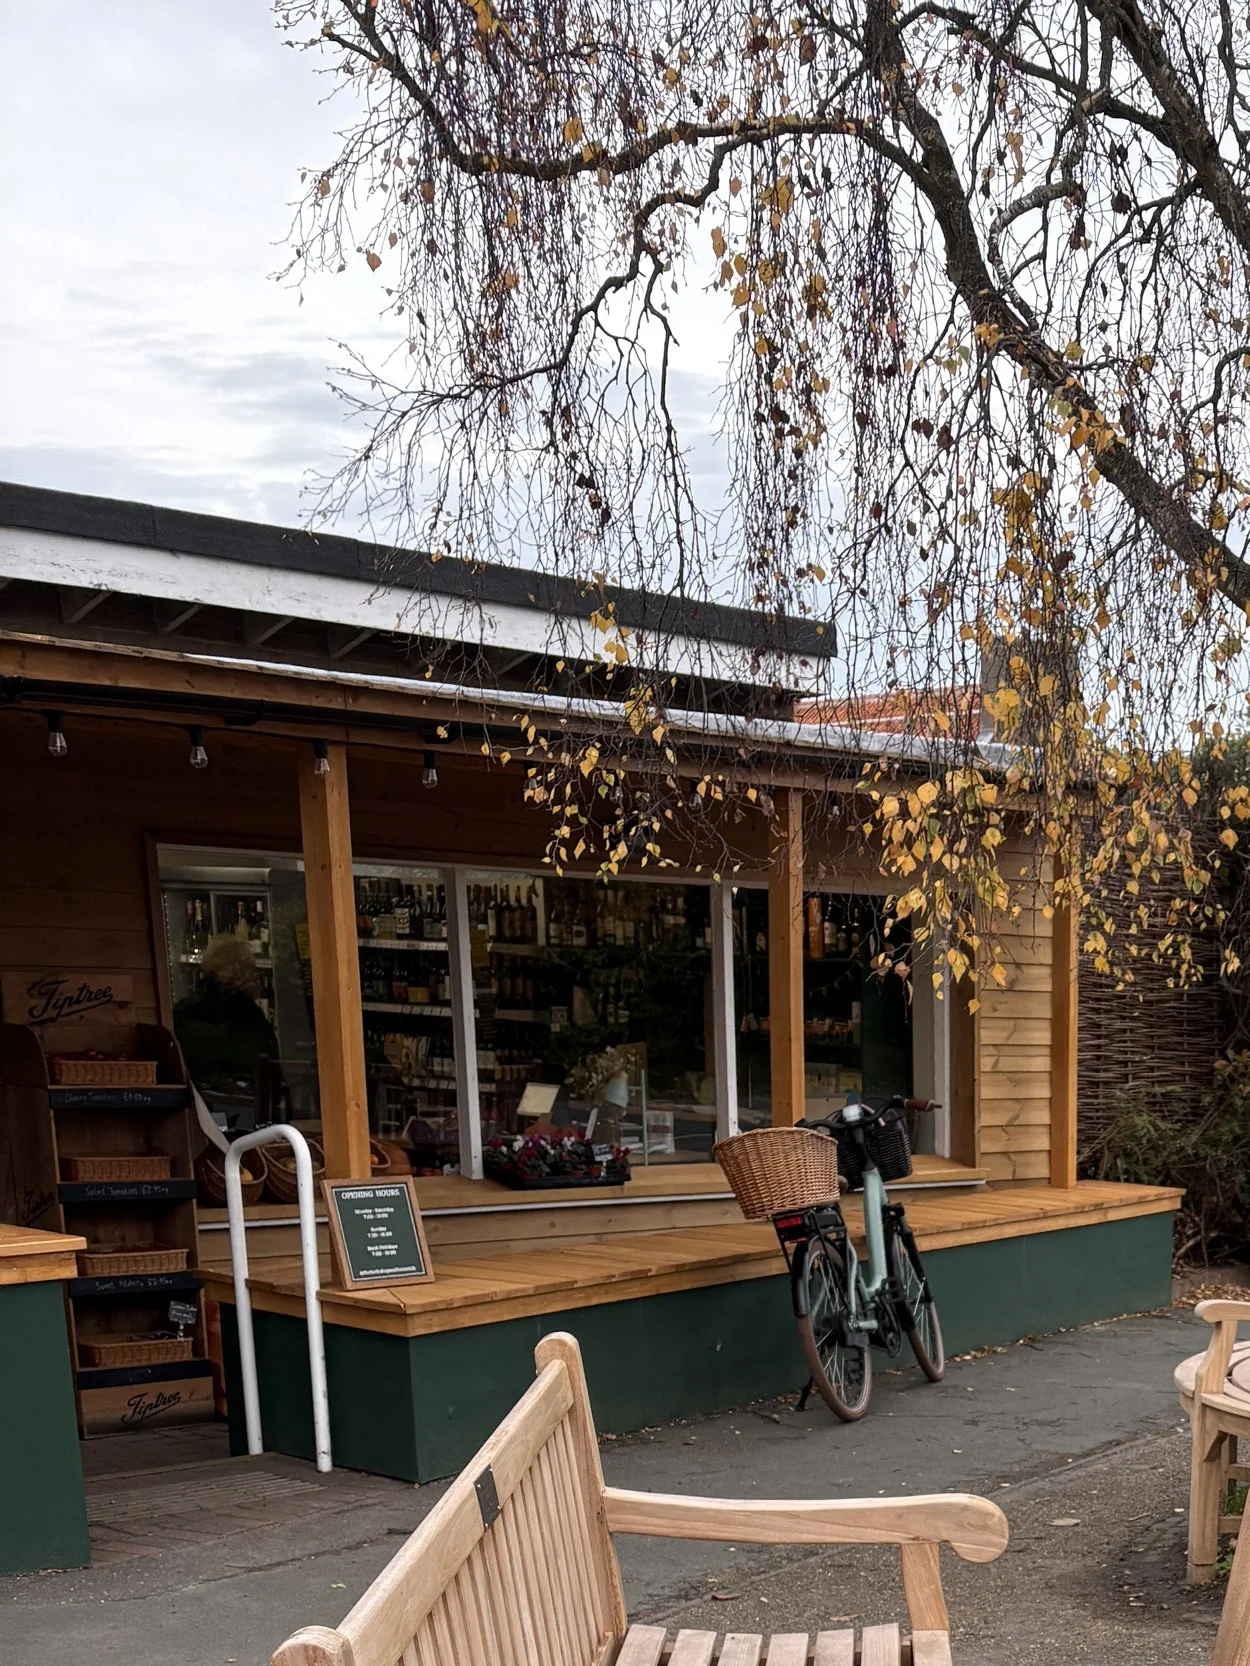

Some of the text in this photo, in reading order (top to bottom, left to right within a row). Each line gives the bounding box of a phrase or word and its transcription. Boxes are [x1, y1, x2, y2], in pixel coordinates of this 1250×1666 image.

[27, 979, 113, 1025] Tiptree
[341, 1188, 400, 1200] OPENING HOURS
[120, 1391, 182, 1425] Tiptree
